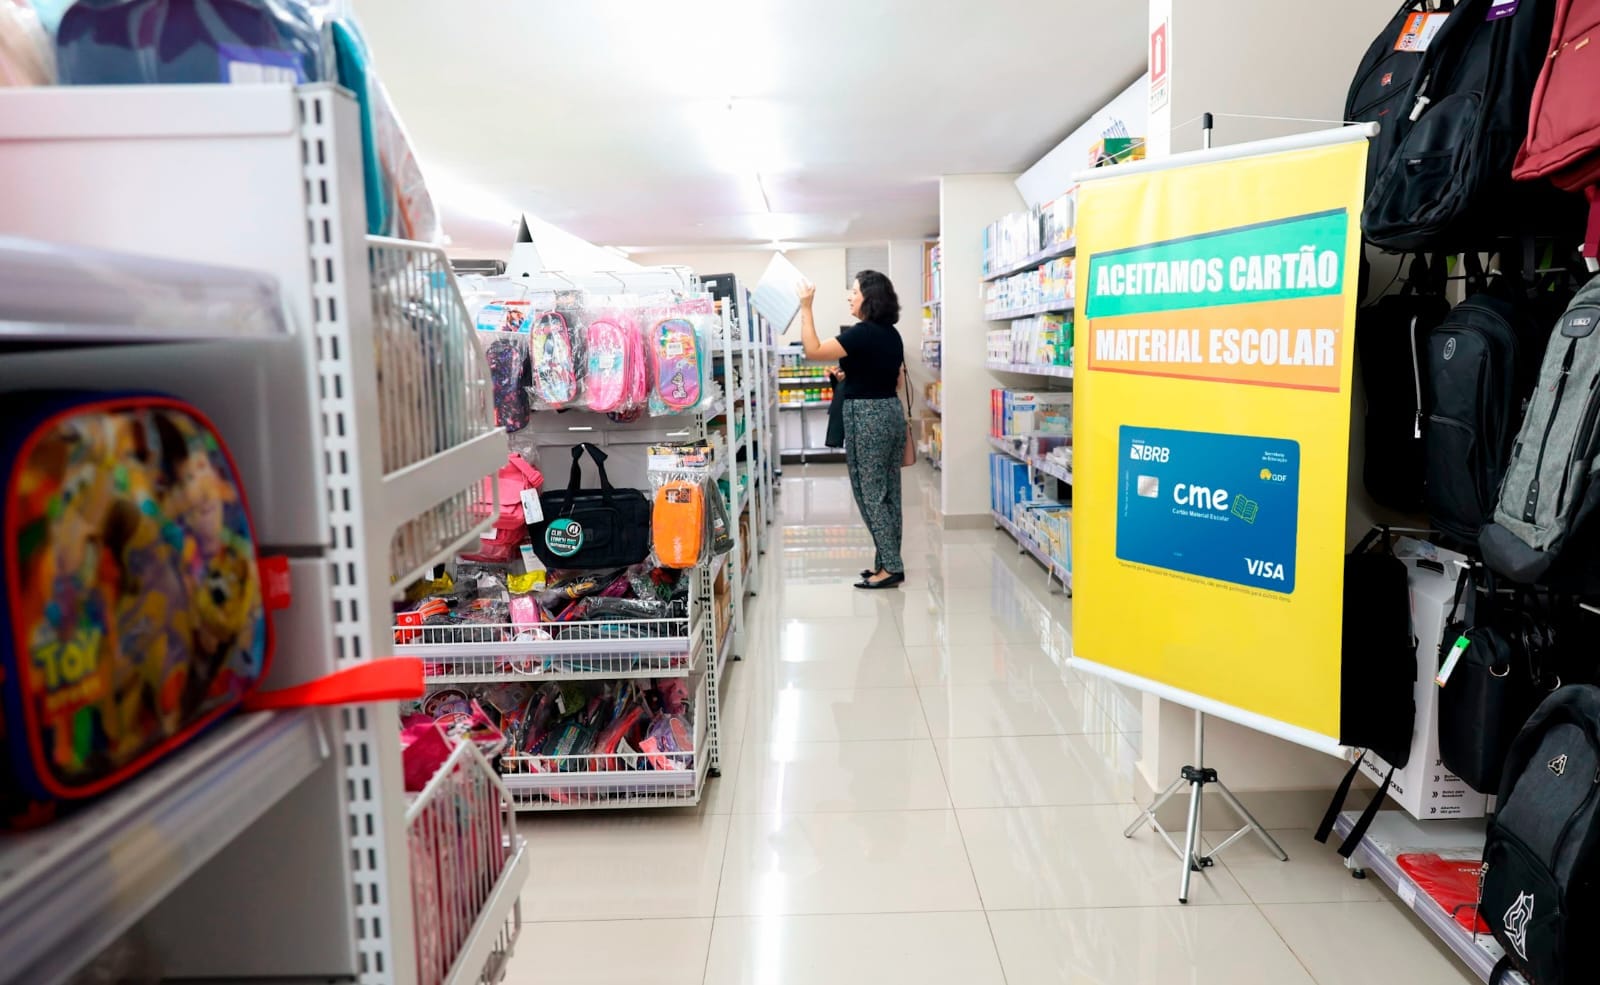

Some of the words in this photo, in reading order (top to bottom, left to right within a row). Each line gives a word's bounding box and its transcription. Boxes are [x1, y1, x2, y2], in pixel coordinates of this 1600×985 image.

[1096, 258, 1224, 296] ACEITAMOS
[1229, 245, 1338, 292] CARTÃO
[1095, 328, 1203, 364] MATERIAL
[1143, 445, 1170, 463] BRB
[1271, 474, 1287, 482] GDF
[1173, 482, 1229, 511] cme
[1172, 507, 1189, 516] Cartão
[1189, 510, 1210, 519] Material
[1209, 513, 1230, 522] Escolar
[1243, 557, 1285, 581] VISA
[36, 629, 101, 689] TOY
[1362, 758, 1384, 778] MOCHILA
